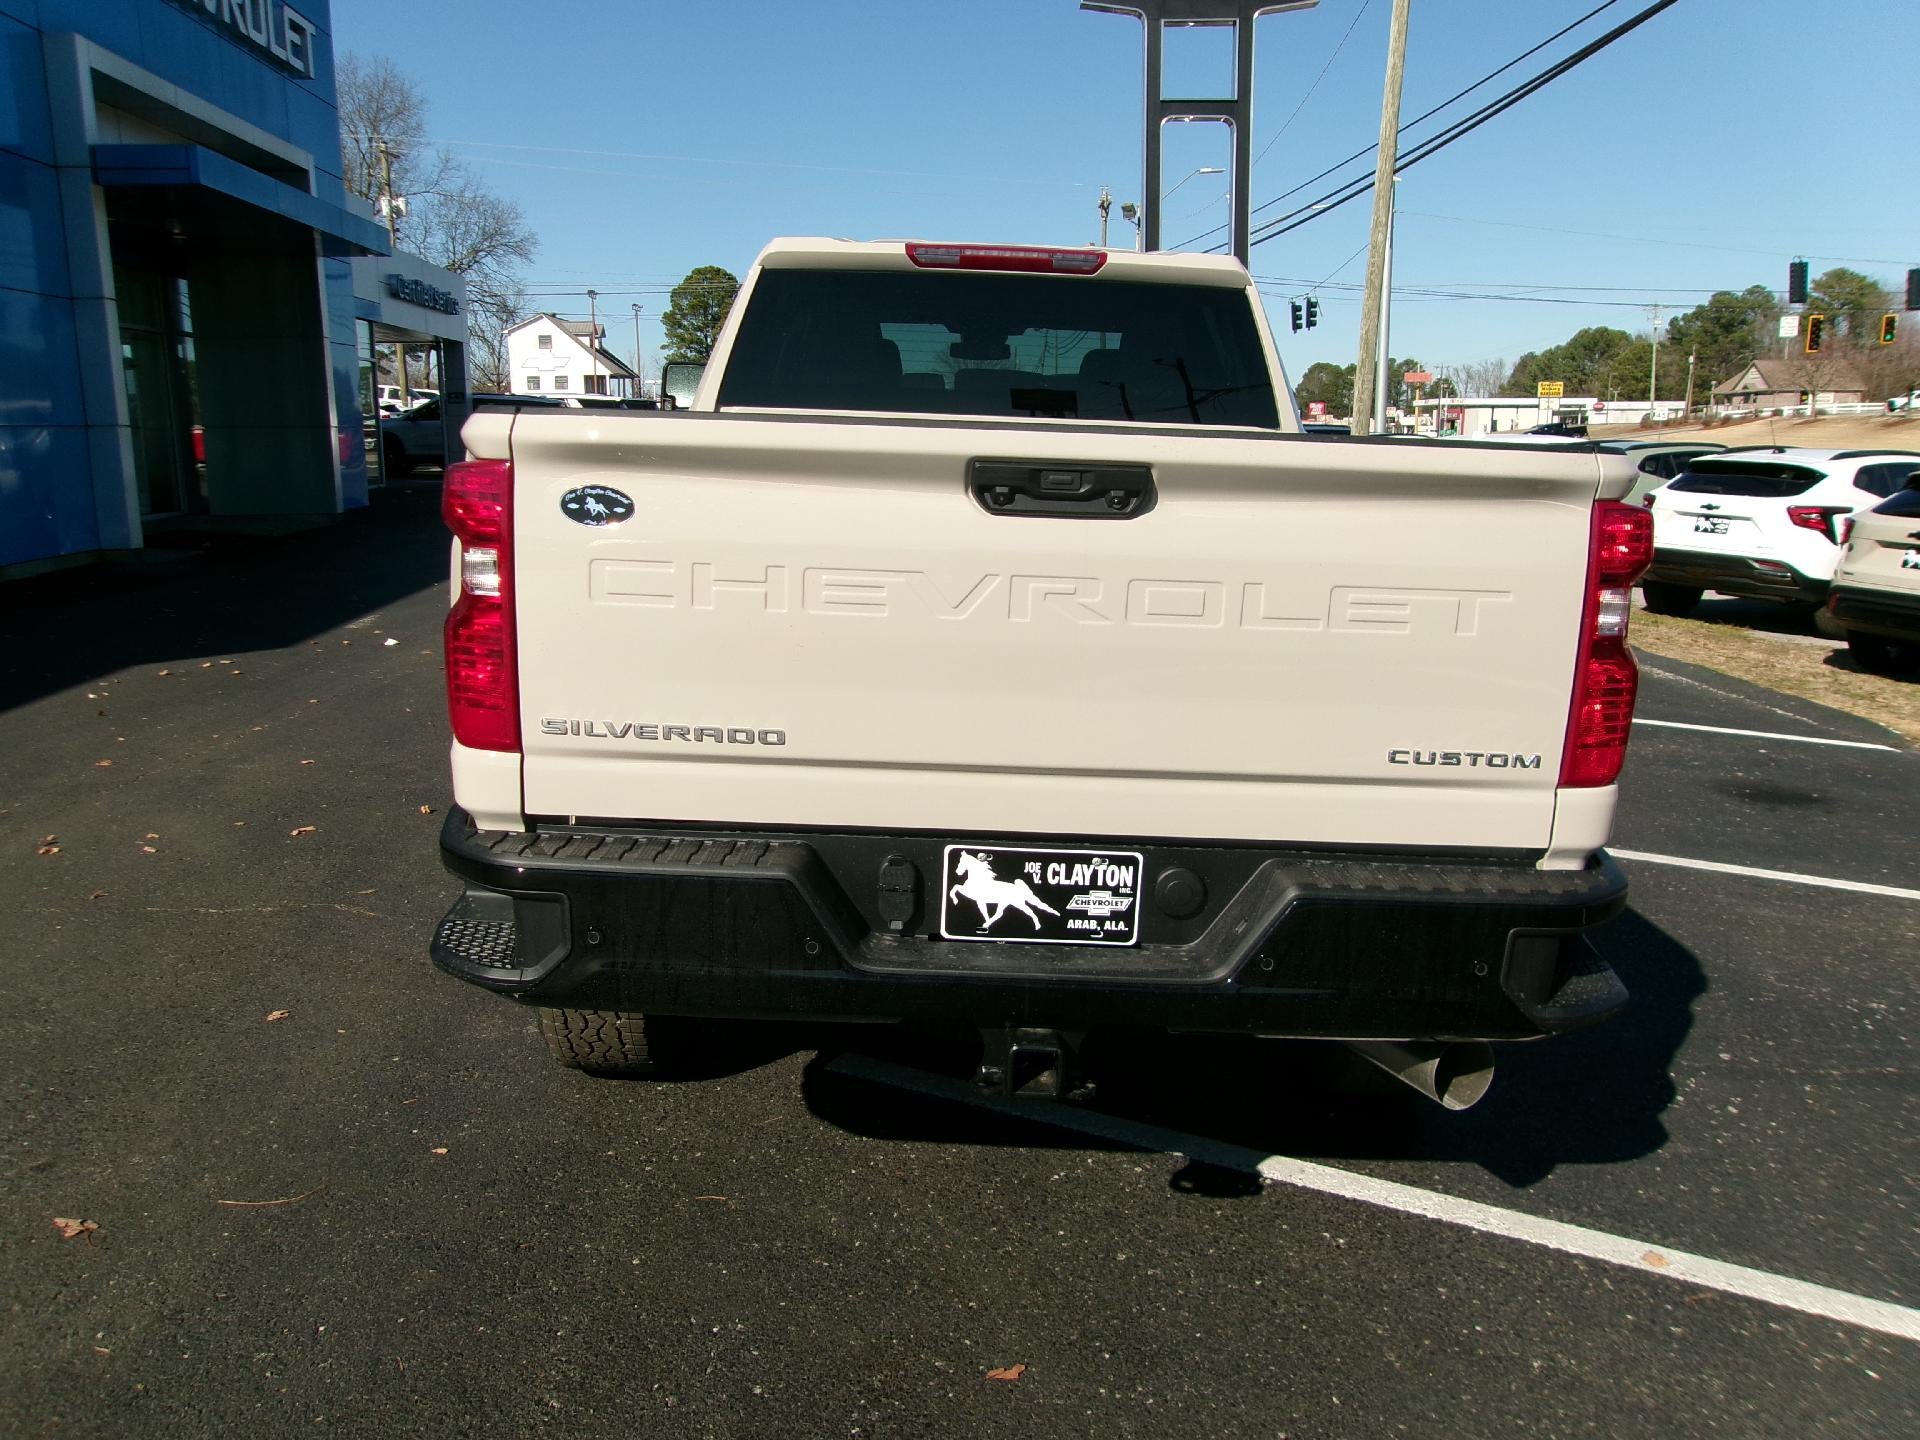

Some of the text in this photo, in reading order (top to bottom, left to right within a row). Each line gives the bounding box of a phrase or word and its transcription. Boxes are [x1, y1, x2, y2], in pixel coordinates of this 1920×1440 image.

[588, 557, 1514, 637] CHEVROLET
[540, 716, 787, 746] SILVERADO
[1388, 749, 1542, 770] CUSTOM
[1023, 861, 1042, 874] JOE
[1033, 873, 1042, 884] V.
[1047, 862, 1134, 888] CLAYTON
[1074, 898, 1125, 908] CHEVROLET
[1067, 919, 1129, 931] ARAB, ALA.
